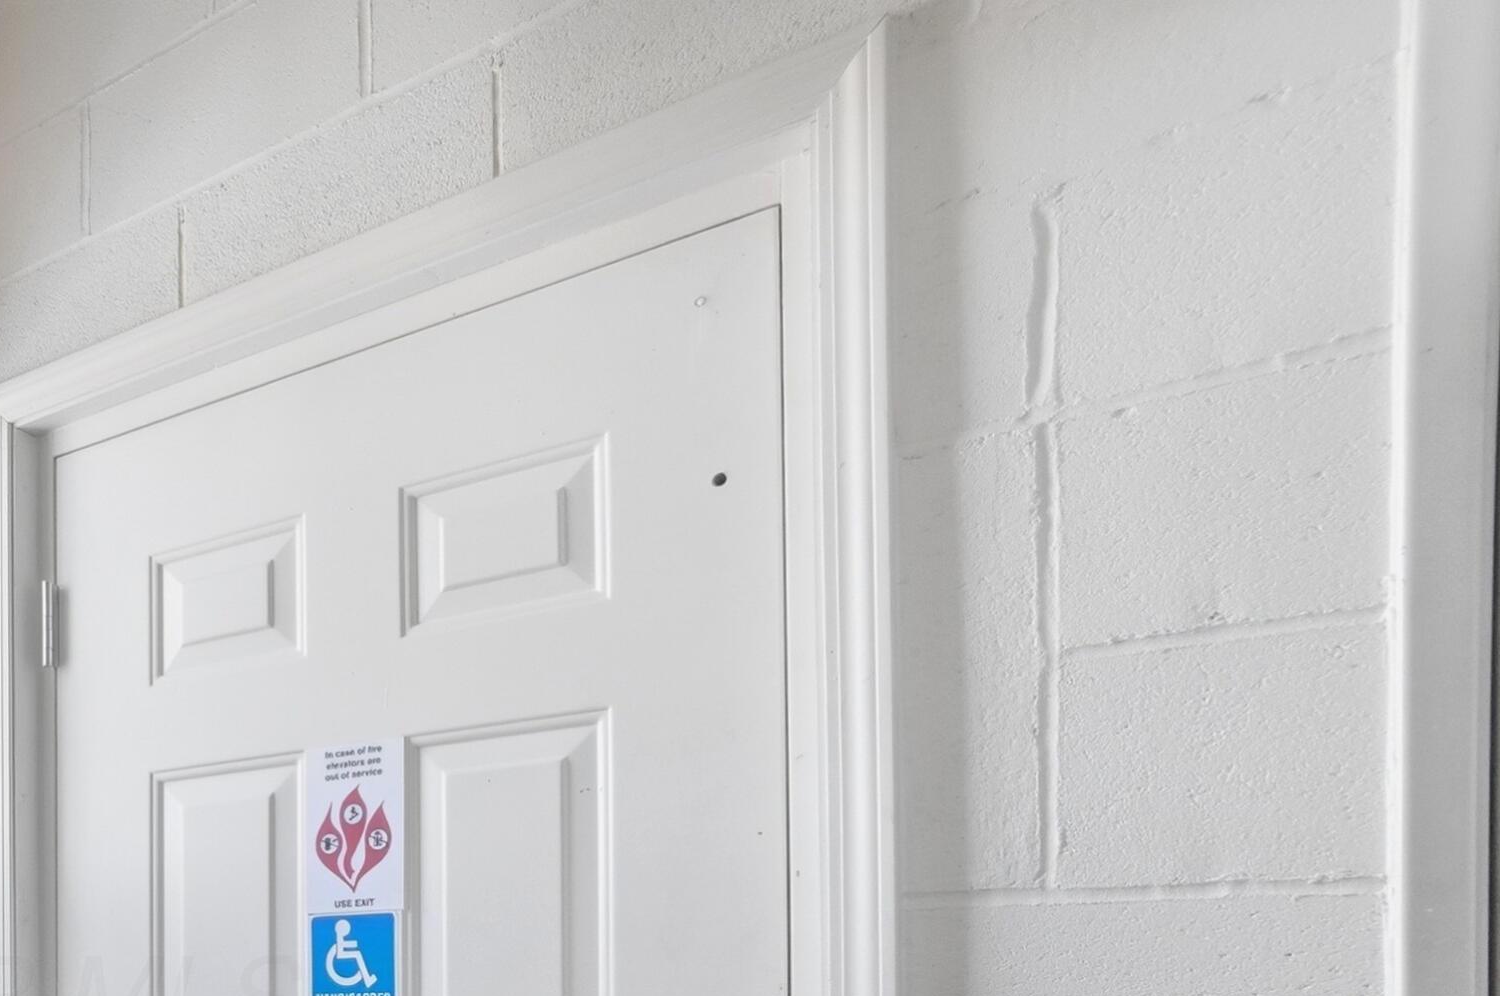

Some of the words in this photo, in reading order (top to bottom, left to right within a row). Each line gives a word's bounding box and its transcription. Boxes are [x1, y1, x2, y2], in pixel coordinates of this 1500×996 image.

[325, 751, 334, 759] In
[335, 750, 355, 758] case
[357, 746, 366, 755] of
[368, 745, 382, 753] fire
[326, 759, 365, 770] elevators
[367, 757, 381, 765] are
[325, 772, 340, 781] out
[341, 771, 350, 780] of
[352, 768, 382, 778] service
[334, 899, 353, 909] USE
[354, 898, 375, 908] EXIT
